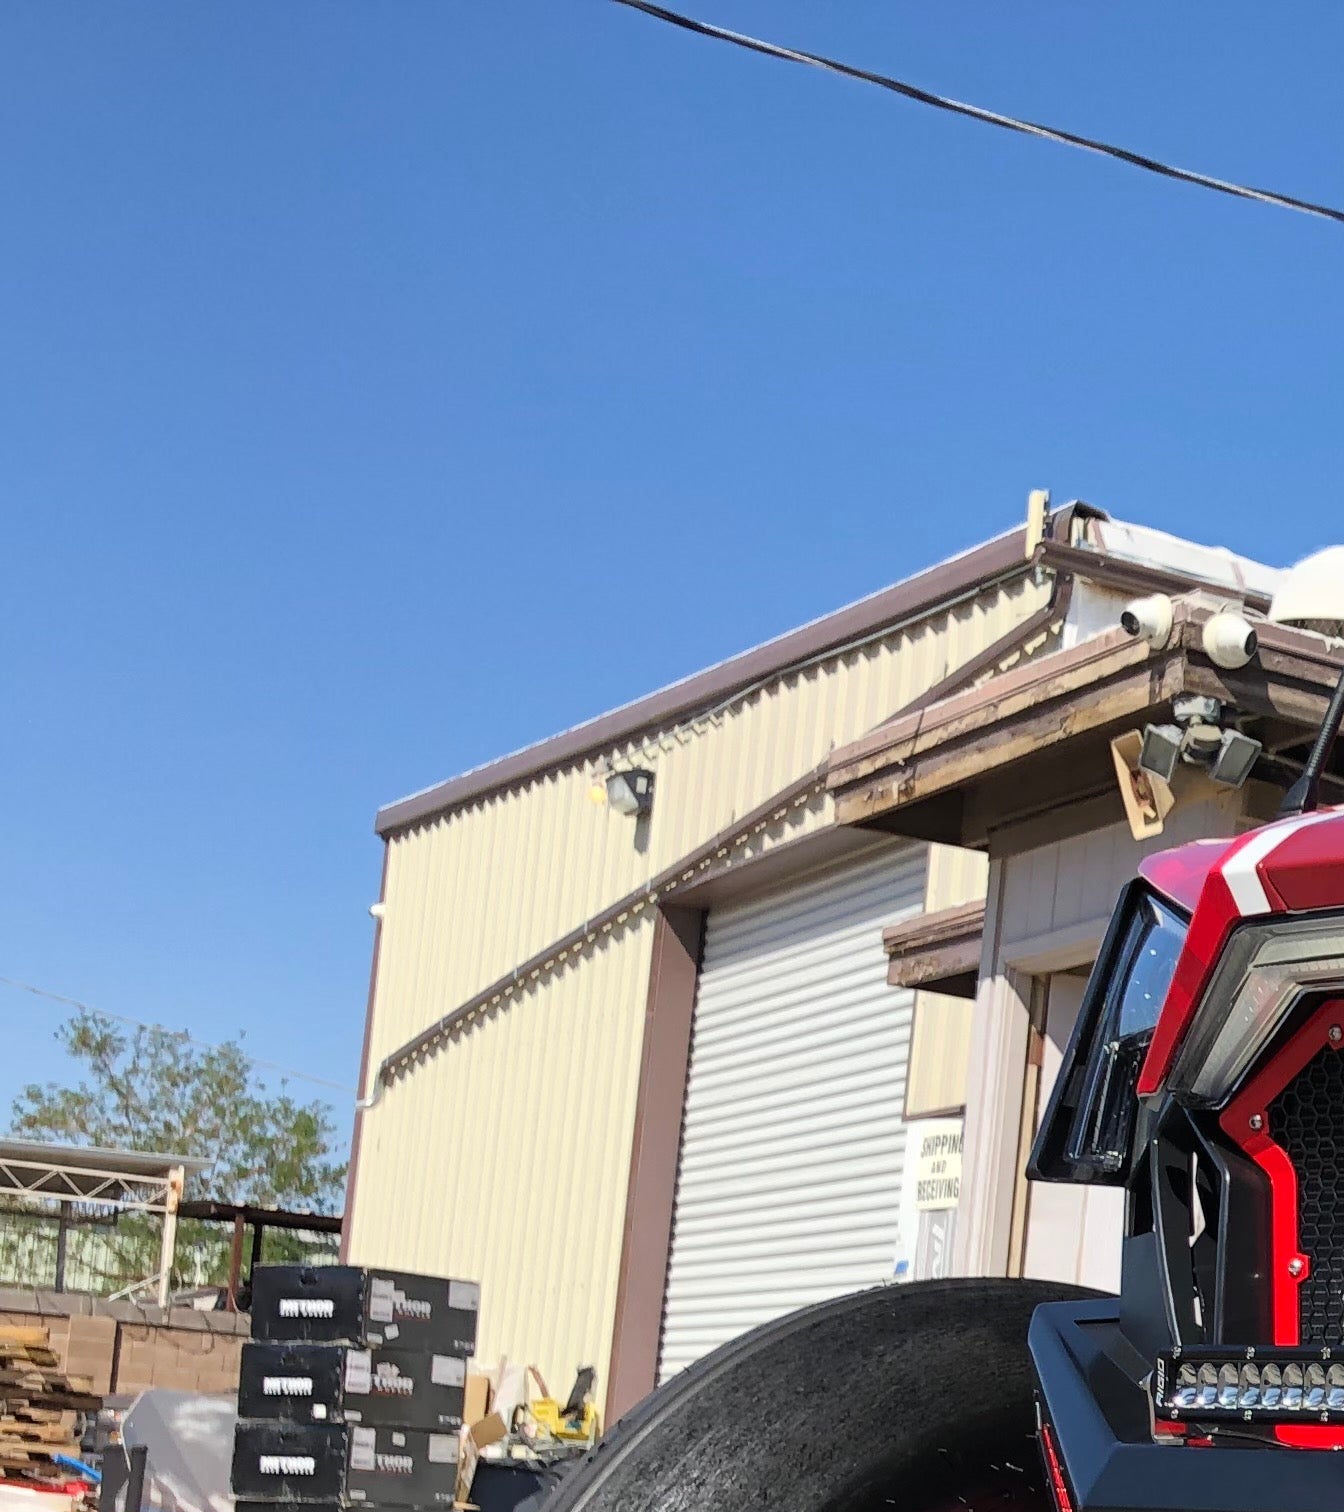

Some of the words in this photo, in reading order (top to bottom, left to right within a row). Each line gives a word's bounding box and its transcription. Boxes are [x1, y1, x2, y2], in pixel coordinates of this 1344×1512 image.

[931, 1160, 946, 1173] AND
[917, 1177, 958, 1201] RECEIVING
[1156, 1358, 1165, 1408] RIGID
